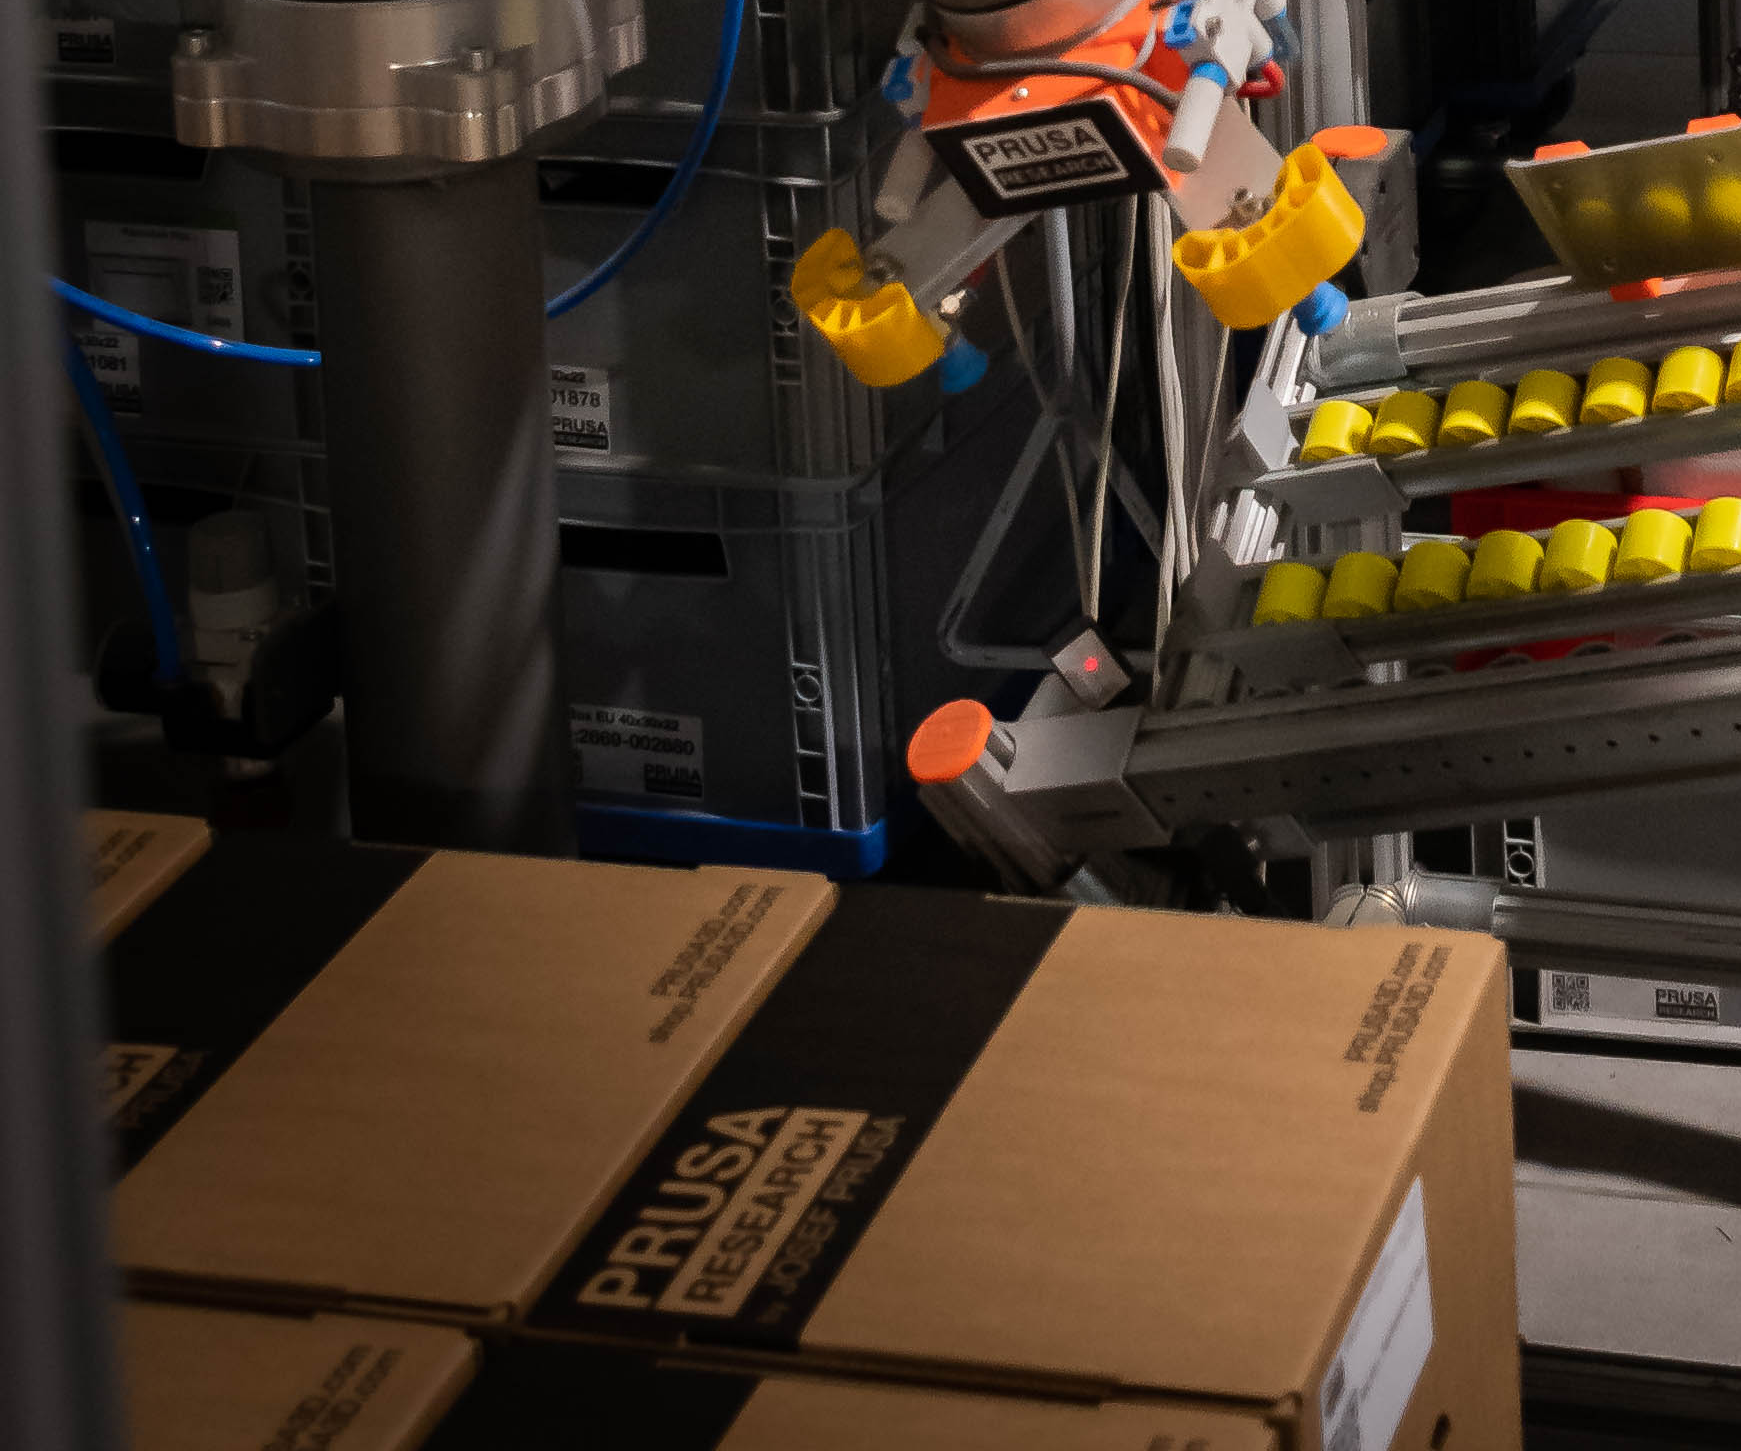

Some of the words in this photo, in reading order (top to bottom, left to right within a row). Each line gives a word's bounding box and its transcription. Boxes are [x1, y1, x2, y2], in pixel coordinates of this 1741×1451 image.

[973, 126, 1100, 165] PRUSA
[1655, 988, 1718, 1007] PRUSA
[576, 1107, 791, 1309] PRUSA
[683, 1117, 844, 1304] RESEARCH
[770, 1205, 840, 1296] JOSEF
[823, 1116, 905, 1203] PRUSA
